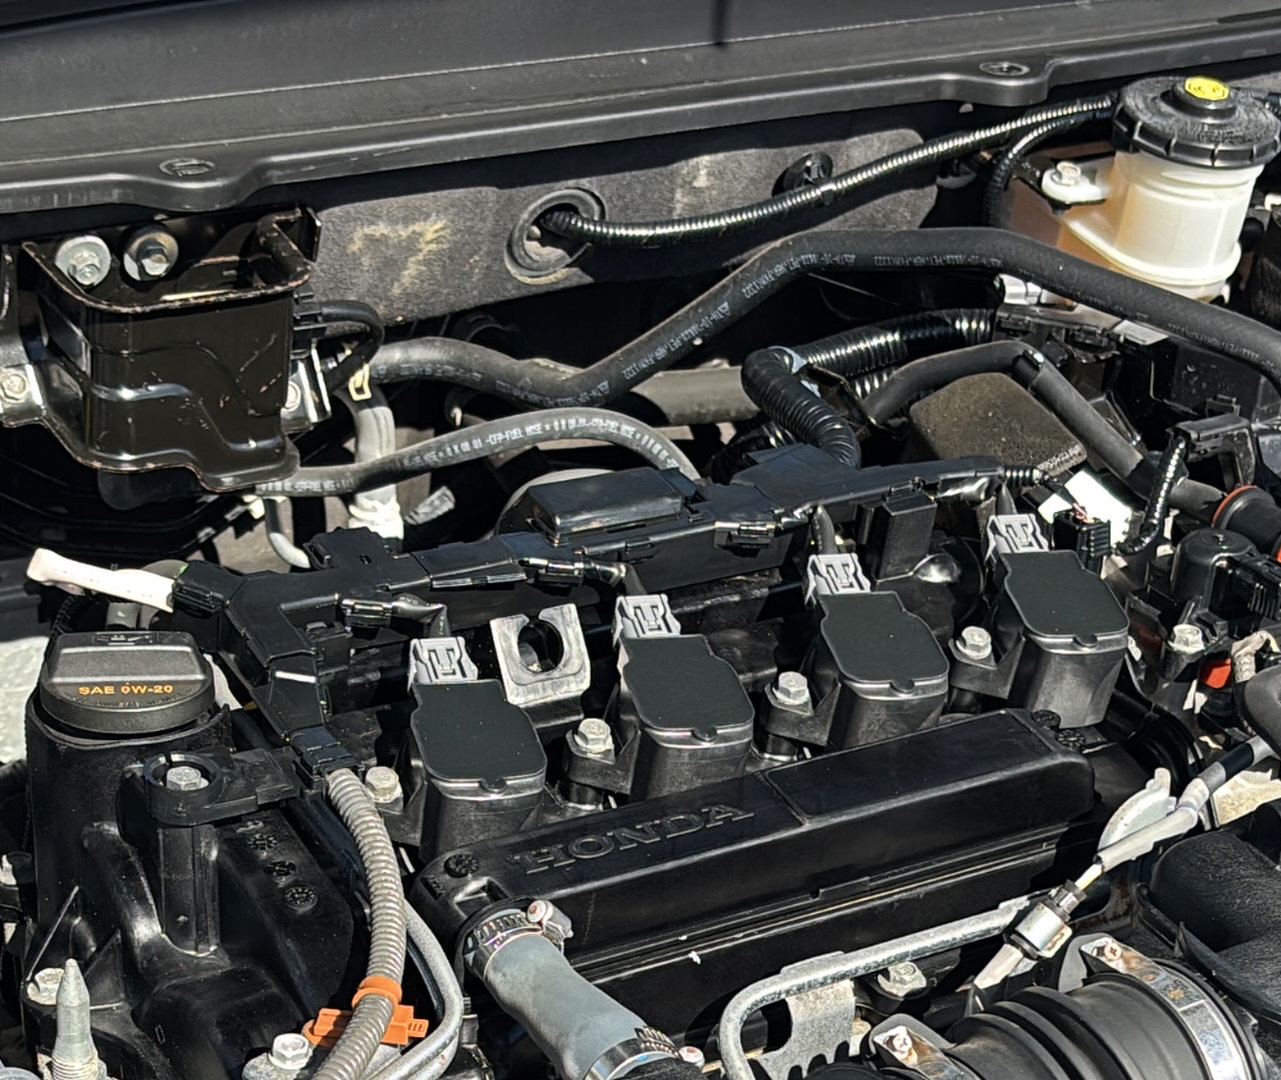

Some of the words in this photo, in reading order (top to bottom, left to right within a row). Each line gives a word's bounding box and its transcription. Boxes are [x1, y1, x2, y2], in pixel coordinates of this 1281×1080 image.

[78, 685, 115, 695] SAE
[121, 682, 173, 694] 0W-20
[515, 802, 755, 875] HONDA
